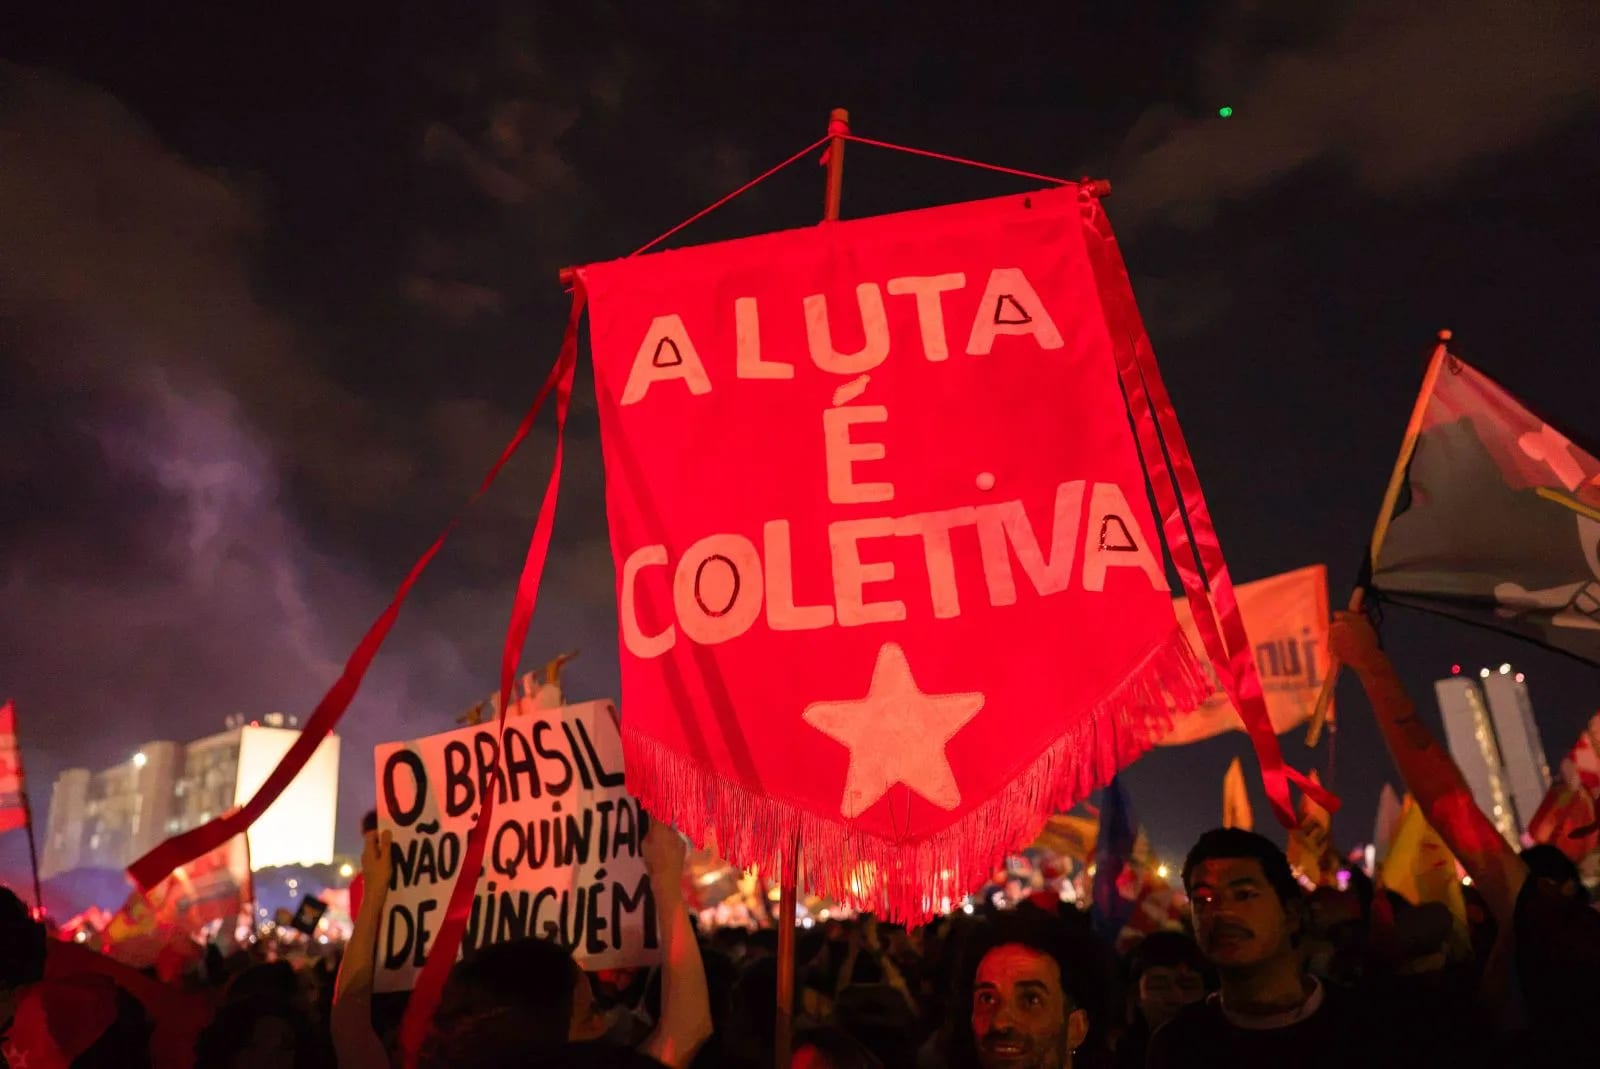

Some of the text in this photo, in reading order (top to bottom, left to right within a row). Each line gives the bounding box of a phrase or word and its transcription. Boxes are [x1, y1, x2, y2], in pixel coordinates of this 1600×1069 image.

[620, 267, 1065, 406] A LUTA
[823, 374, 896, 505] É
[621, 472, 1171, 659] COLETIVA
[383, 717, 625, 826] O BRASIL
[388, 818, 460, 891] NÃO
[384, 899, 438, 970] DE
